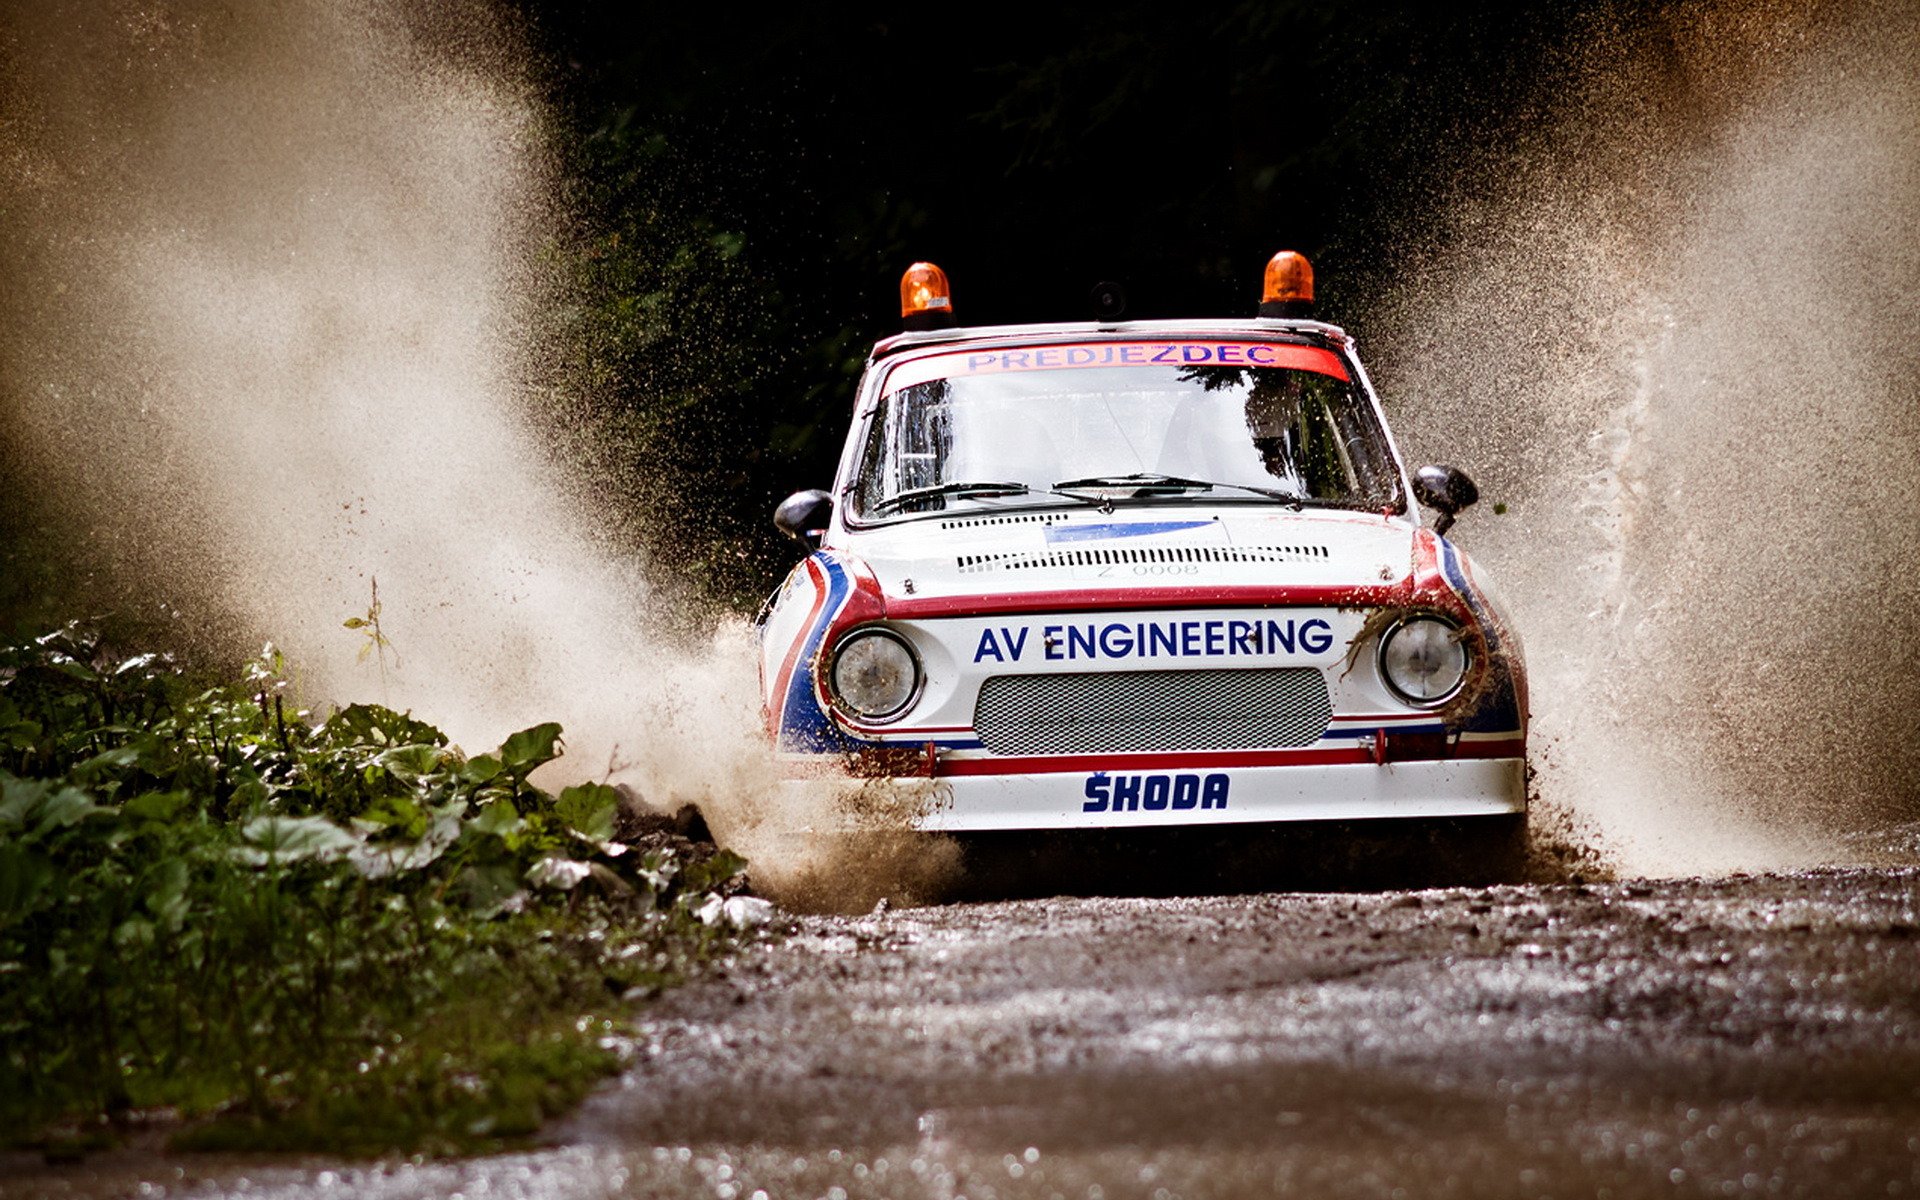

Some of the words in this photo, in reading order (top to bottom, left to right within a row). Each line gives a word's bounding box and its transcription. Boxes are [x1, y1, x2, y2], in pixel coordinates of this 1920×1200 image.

[967, 345, 1275, 371] PREDJEZDEC
[973, 626, 1029, 663] AV
[1045, 618, 1334, 660] ENGINEERING
[1083, 772, 1230, 812] ŠKODA
